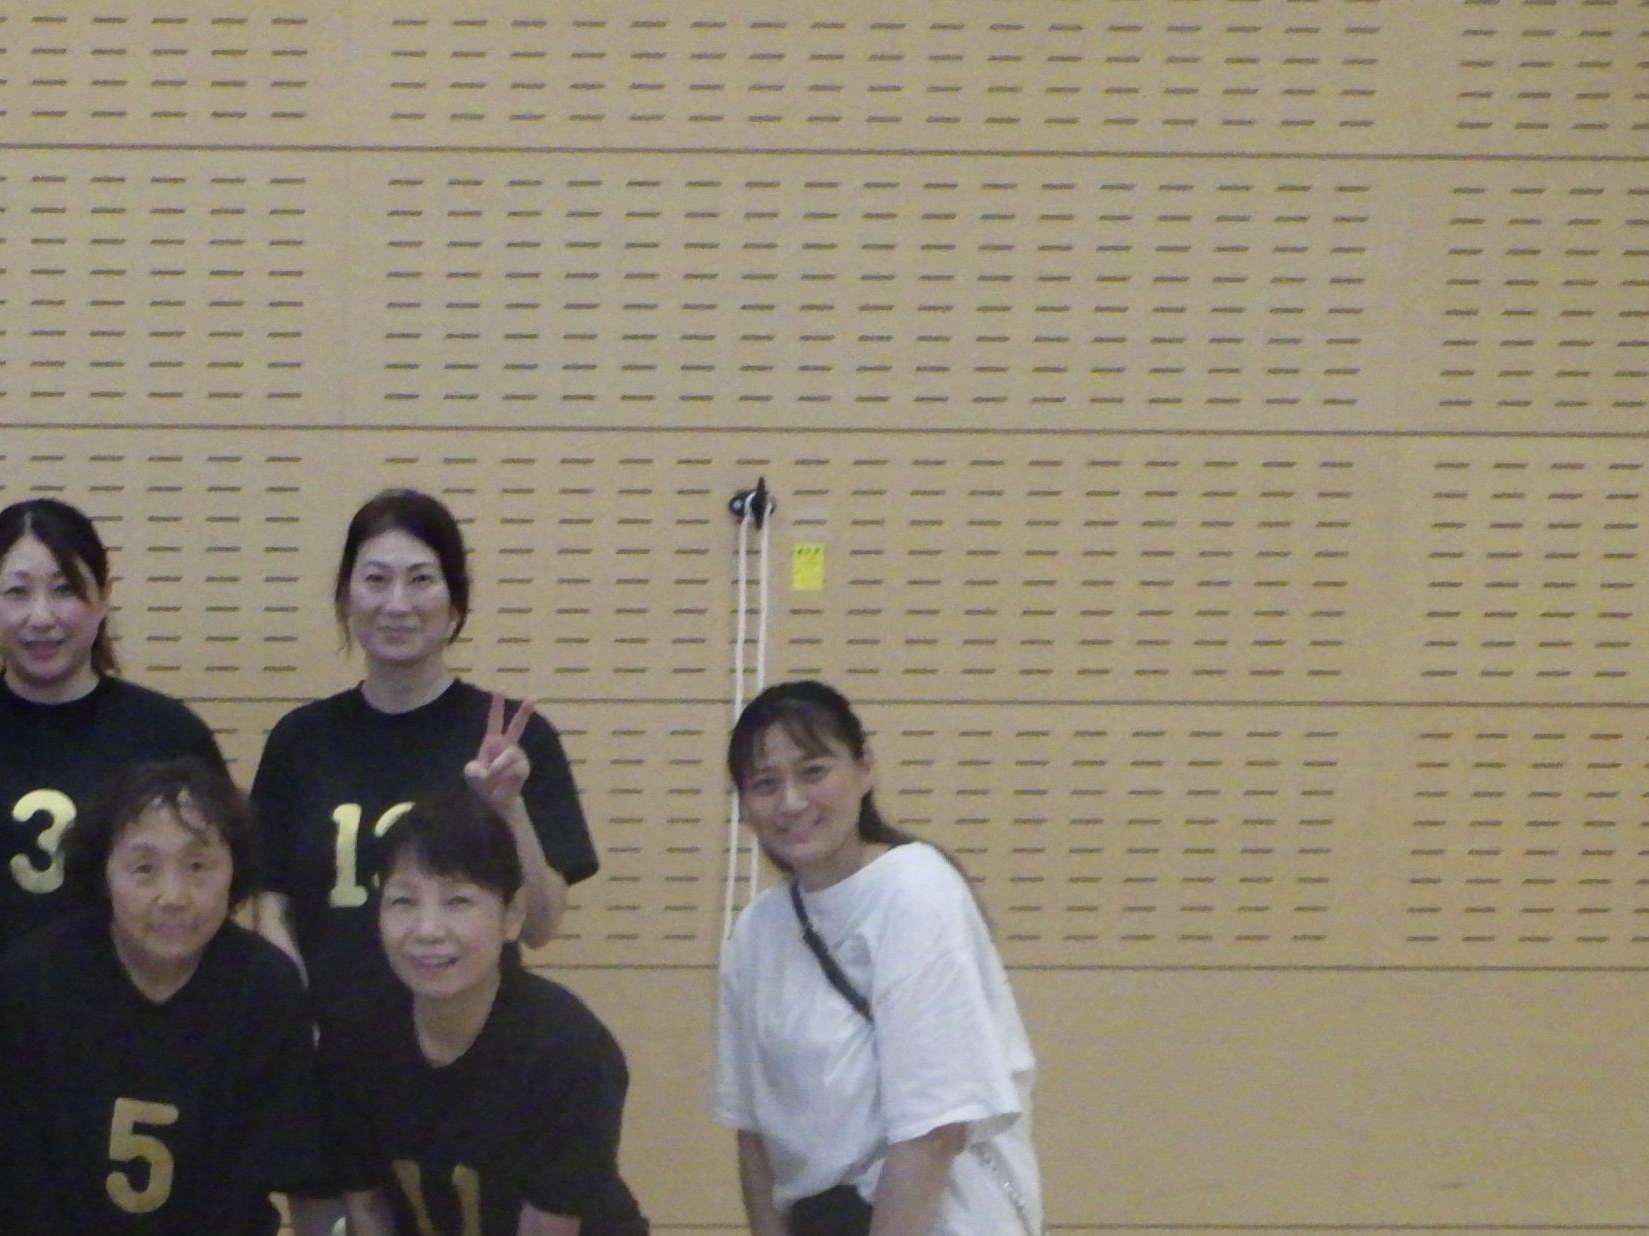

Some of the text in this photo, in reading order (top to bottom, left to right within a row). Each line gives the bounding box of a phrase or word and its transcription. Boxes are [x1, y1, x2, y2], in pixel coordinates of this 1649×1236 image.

[10, 788, 78, 895] 3
[329, 801, 416, 908] 1
[105, 1097, 179, 1214] 5
